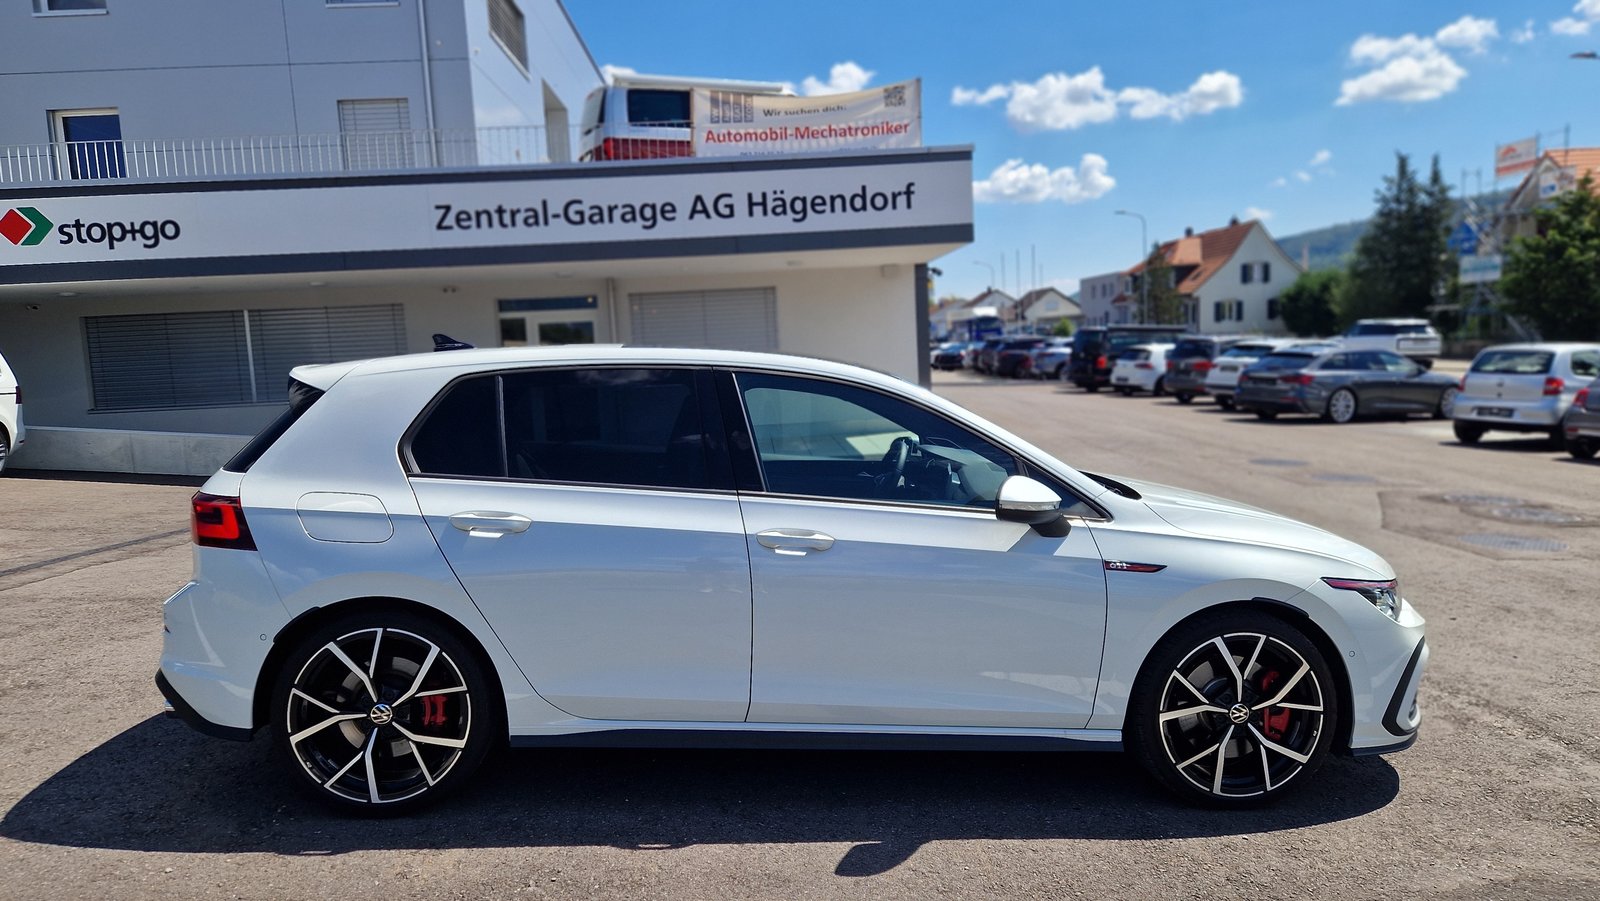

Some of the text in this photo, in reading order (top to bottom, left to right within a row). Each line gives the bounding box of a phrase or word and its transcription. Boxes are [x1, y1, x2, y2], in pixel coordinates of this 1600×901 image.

[763, 108, 781, 117] Wir
[784, 106, 819, 115] suchen
[705, 121, 910, 143] Automobil-Mechatroniker
[435, 183, 915, 231] Zentral-Garage AG Hägendorf
[57, 217, 181, 250] stop+go
